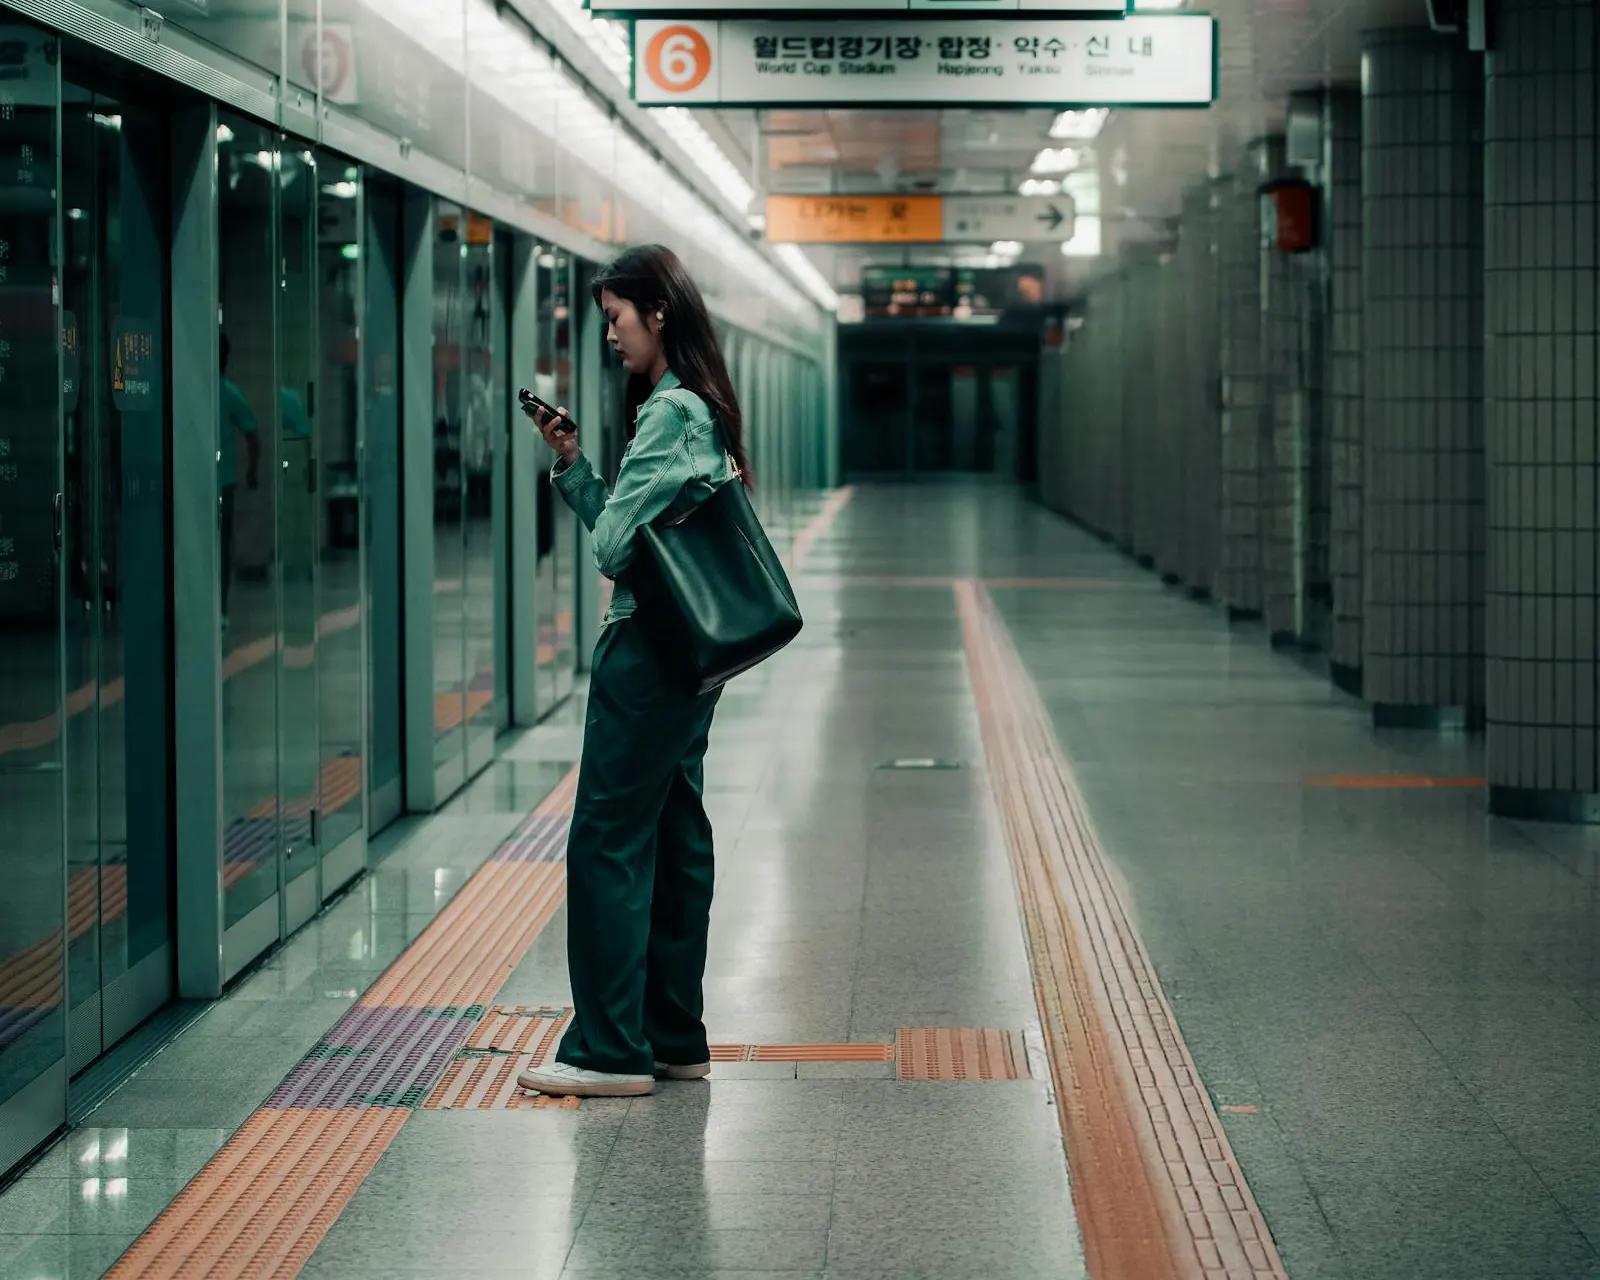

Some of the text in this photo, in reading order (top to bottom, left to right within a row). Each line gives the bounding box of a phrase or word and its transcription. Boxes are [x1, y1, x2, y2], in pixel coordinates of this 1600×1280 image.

[754, 36, 922, 59] 월드컵경기장
[937, 36, 992, 59] 합정
[1013, 36, 1067, 58] 약수
[660, 34, 696, 85] 6
[755, 62, 797, 75] World
[803, 62, 831, 76] Cup
[838, 62, 897, 75] Stadium
